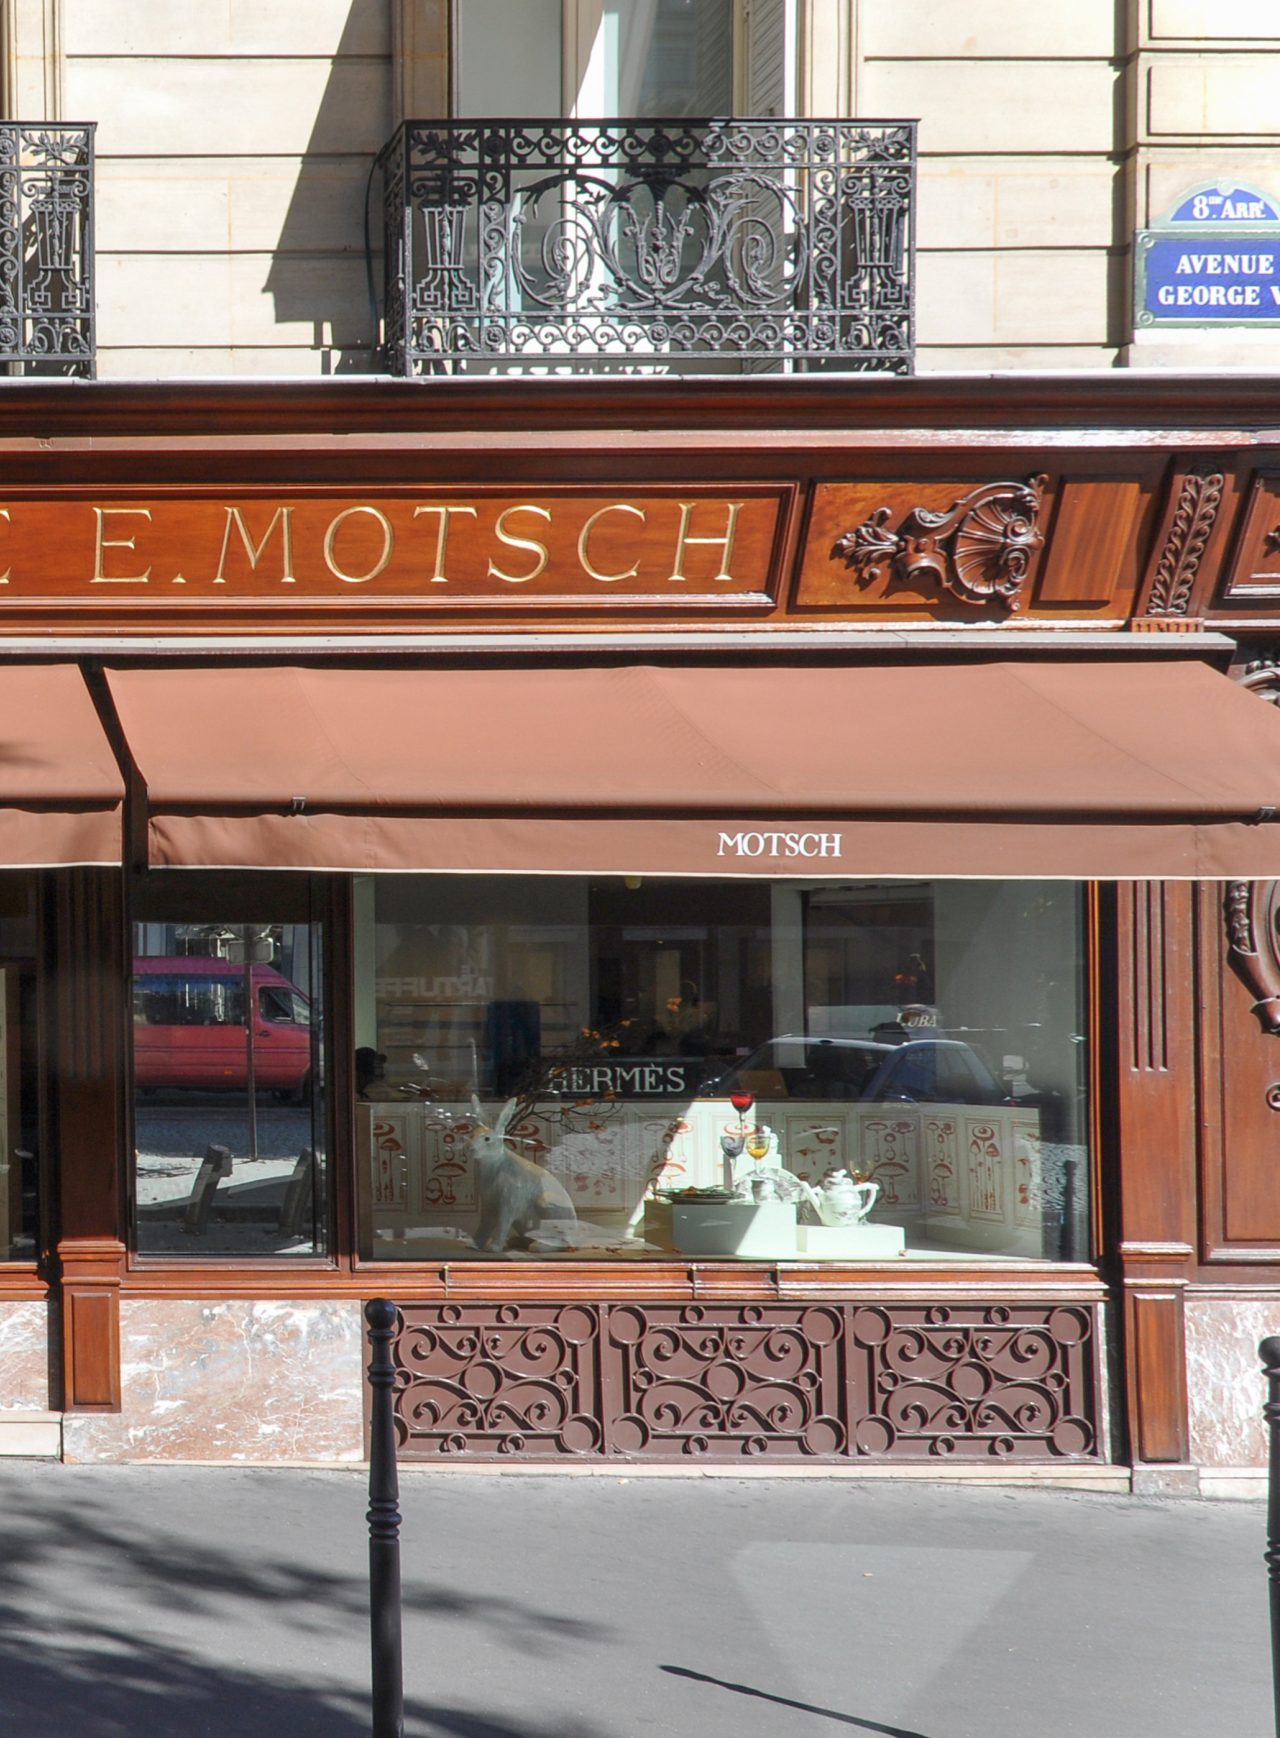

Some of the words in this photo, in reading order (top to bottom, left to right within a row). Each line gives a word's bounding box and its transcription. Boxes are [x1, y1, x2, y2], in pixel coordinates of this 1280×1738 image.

[1176, 255, 1274, 274] AVENUE
[1158, 286, 1260, 305] GEORGE
[717, 832, 842, 857] MOTSCH
[548, 1063, 686, 1092] HERMÈS
